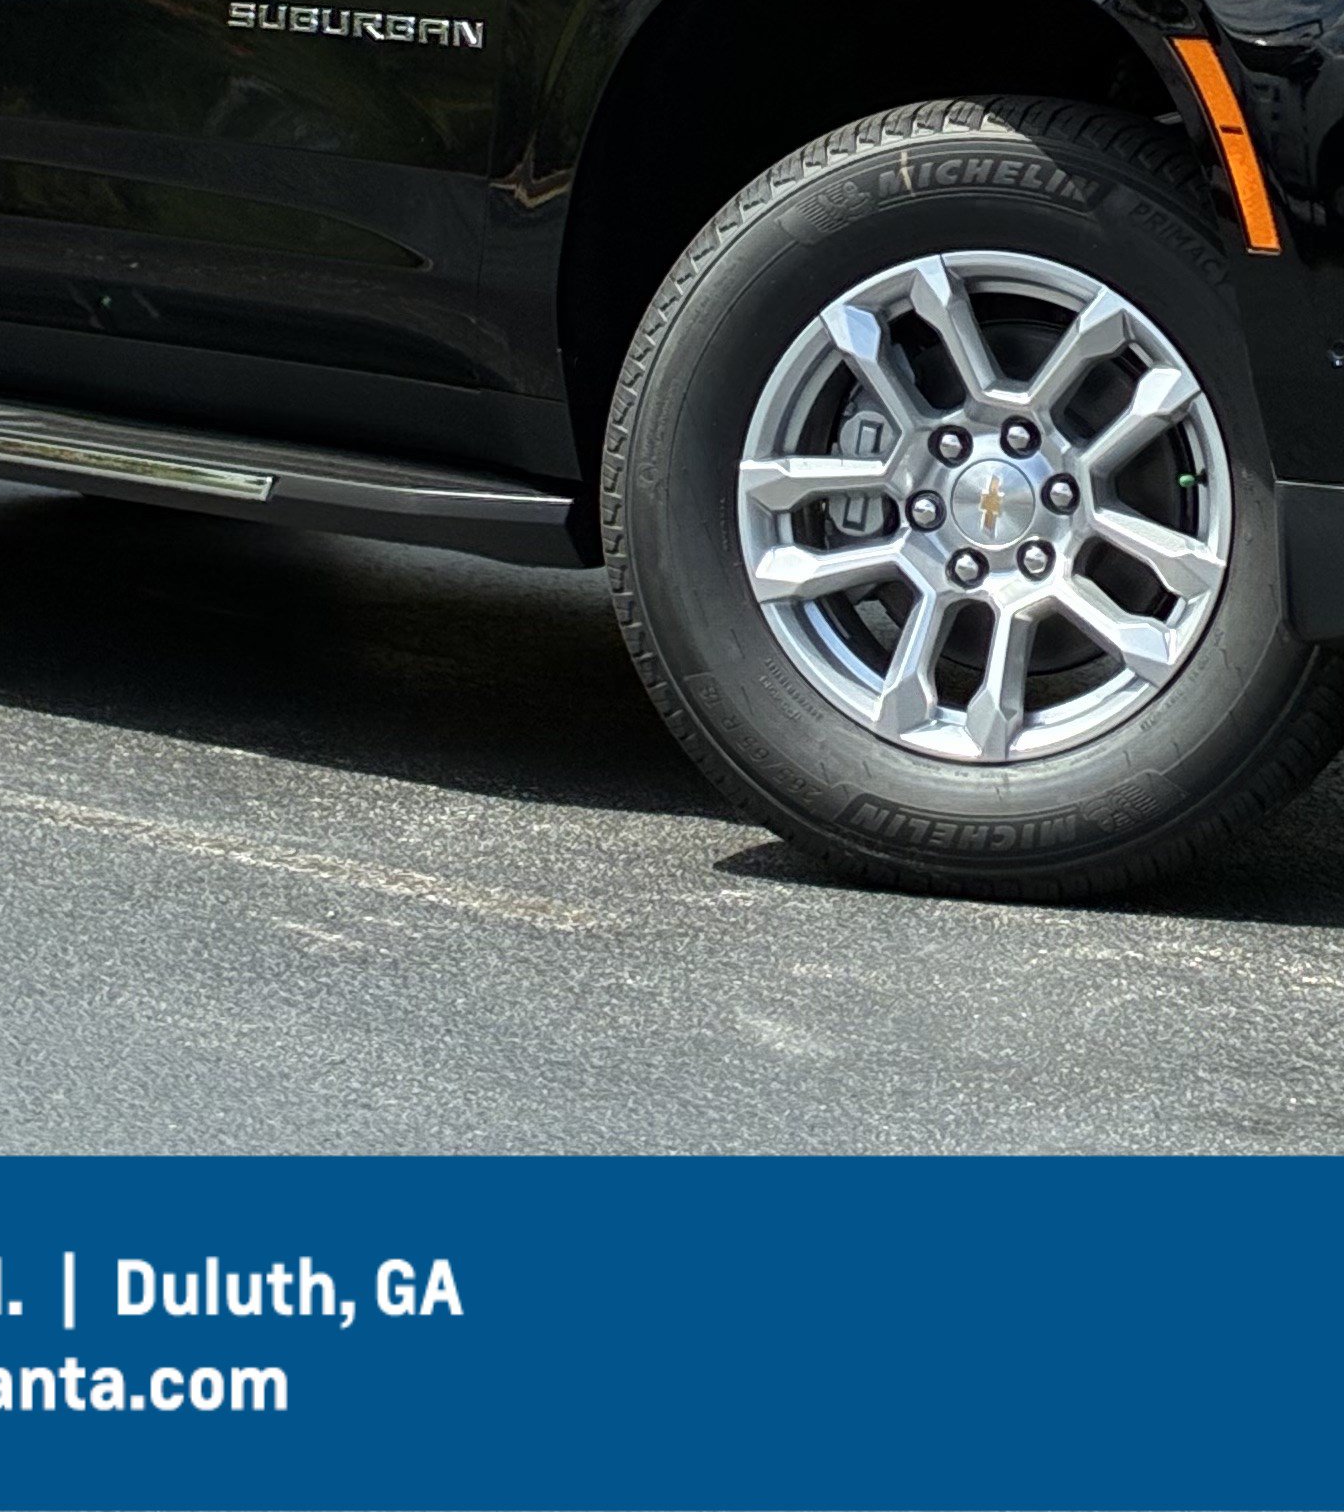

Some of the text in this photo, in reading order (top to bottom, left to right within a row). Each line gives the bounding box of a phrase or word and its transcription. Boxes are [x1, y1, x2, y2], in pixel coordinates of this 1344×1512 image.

[227, 1, 484, 49] SUBURBAN
[878, 157, 1100, 203] MICHELIN
[851, 802, 1077, 851] MICHELIN
